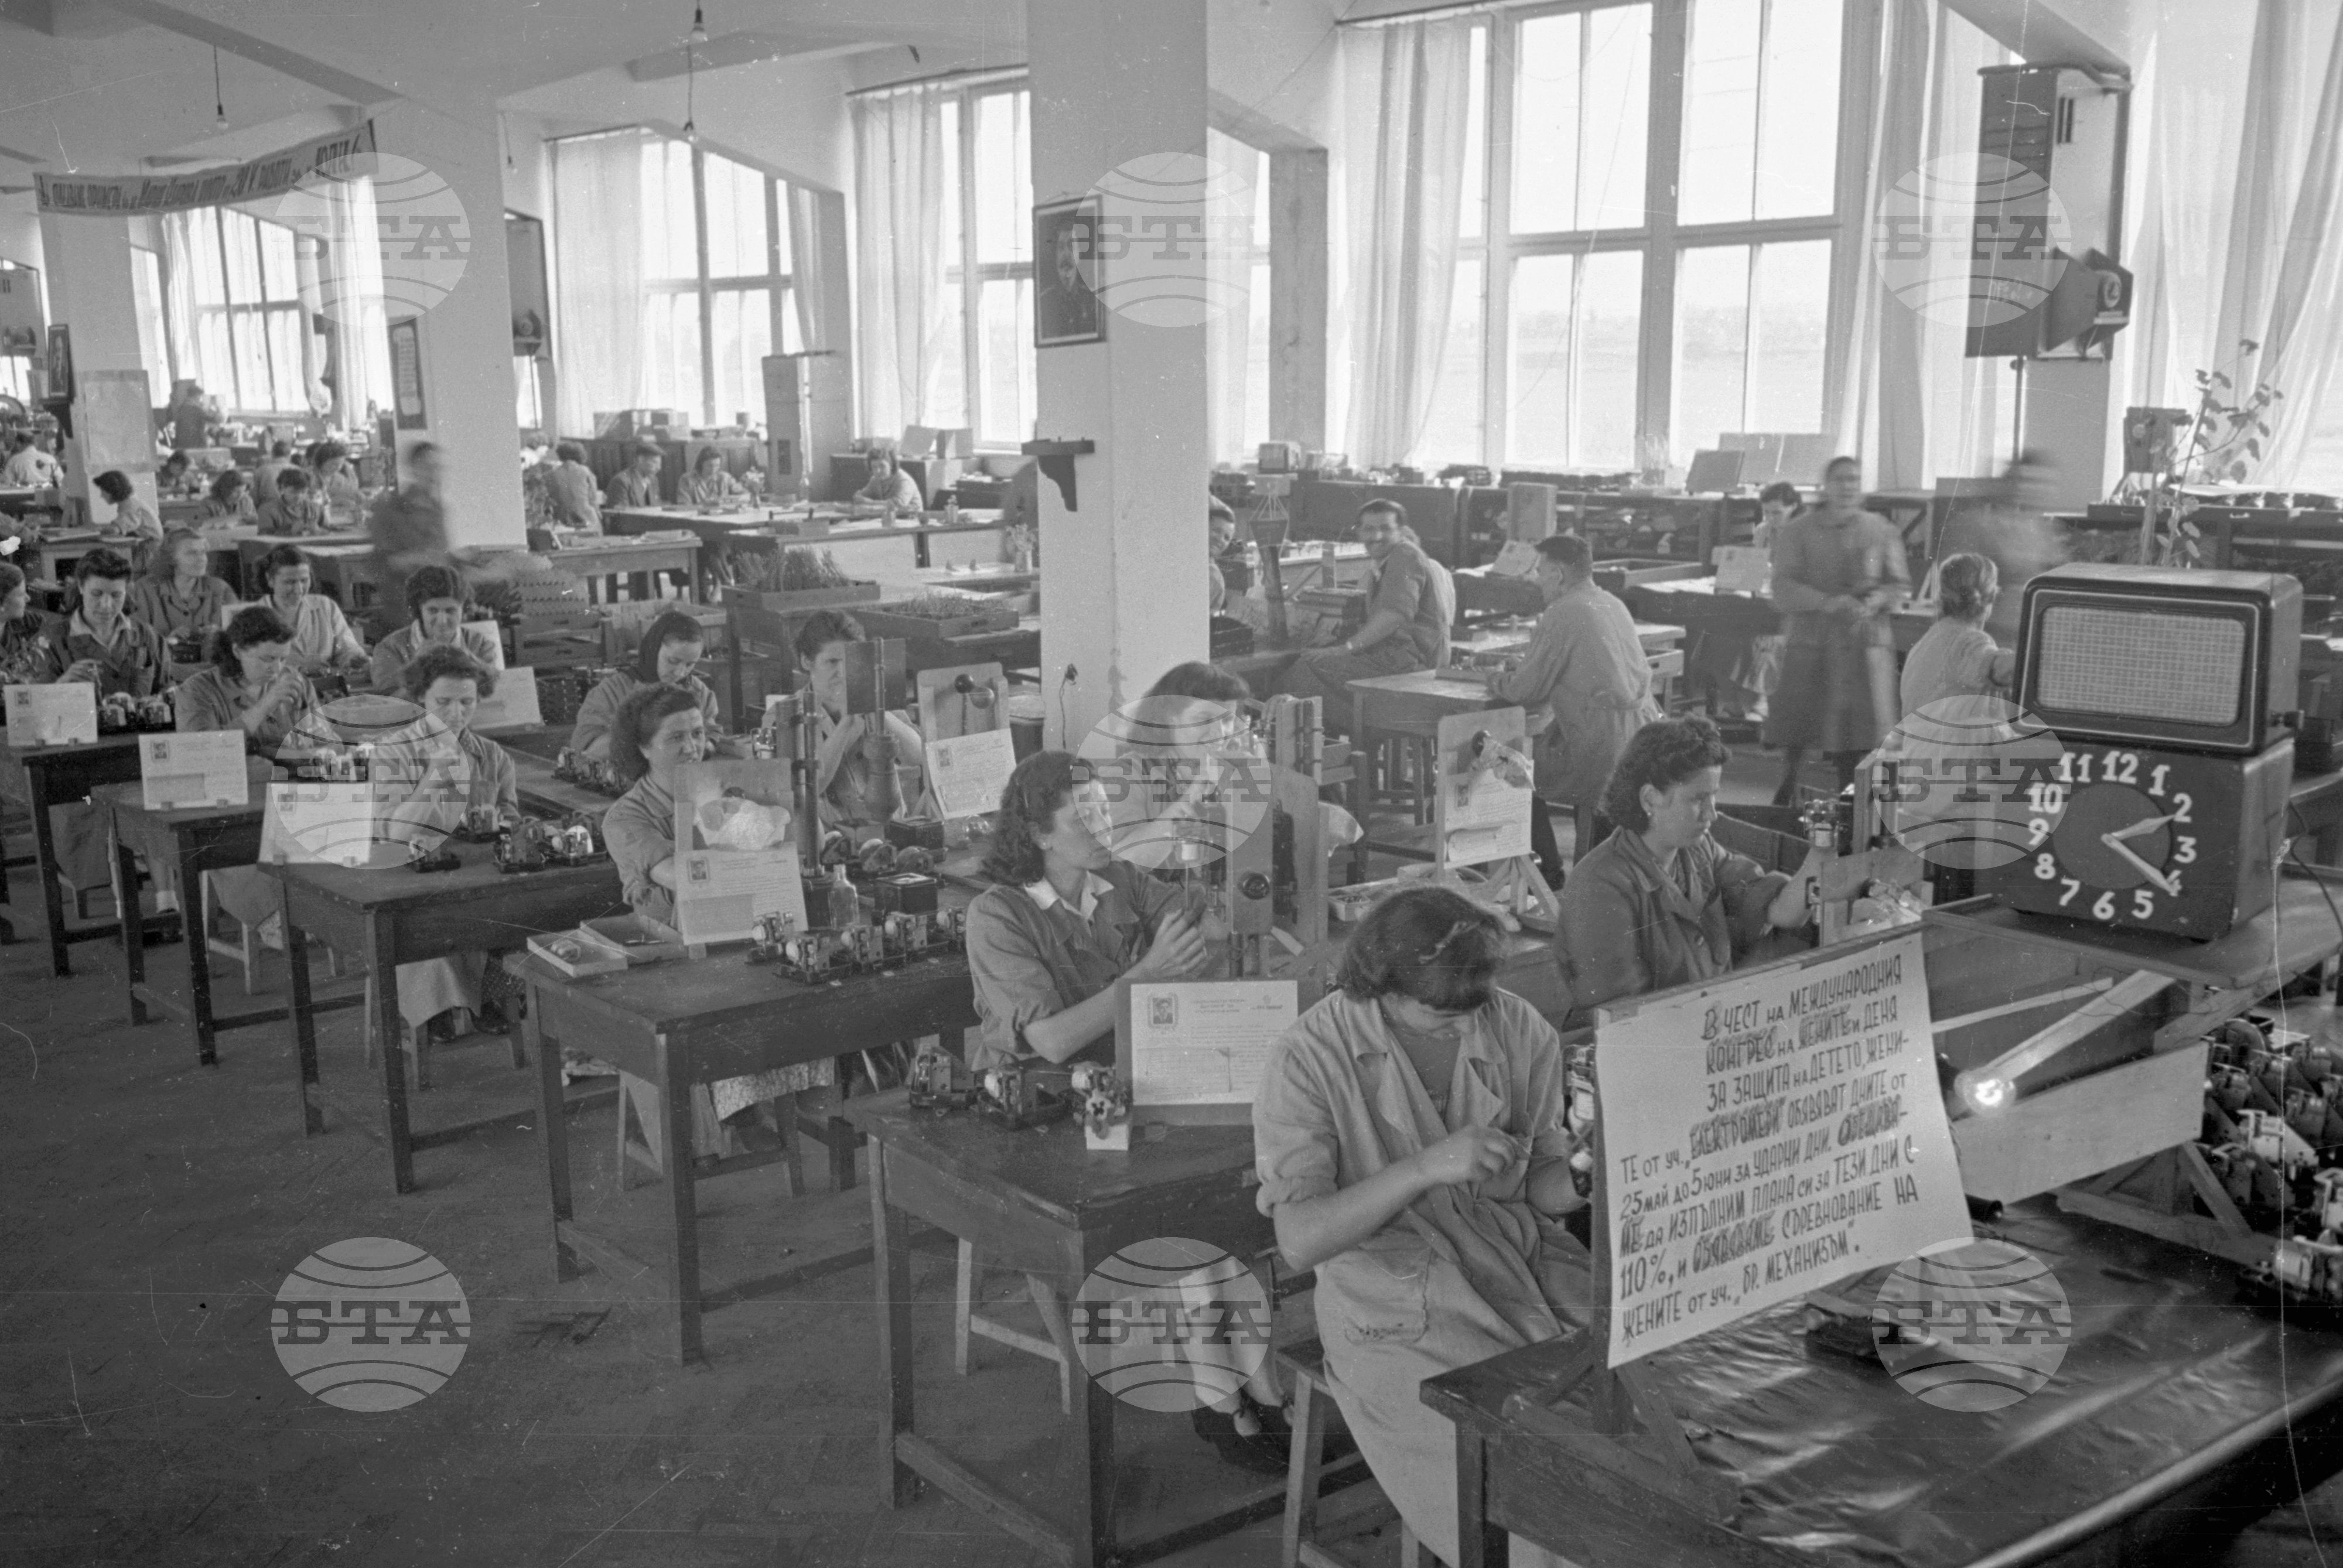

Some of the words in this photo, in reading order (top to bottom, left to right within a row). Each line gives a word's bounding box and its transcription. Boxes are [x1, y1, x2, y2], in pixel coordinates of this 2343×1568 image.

[2058, 752, 2093, 783] 11
[2102, 750, 2139, 784] 12
[2149, 764, 2171, 796] 1
[2028, 782, 2062, 815] 10
[2174, 792, 2192, 822] 2
[2028, 818, 2049, 846] 9
[2174, 835, 2197, 863] 3
[2034, 852, 2056, 879] 8
[2058, 877, 2081, 906] 7
[2166, 869, 2183, 897] 4
[2092, 891, 2115, 919] 6
[2130, 889, 2154, 919] 5
[1702, 1003, 1720, 1040] В
[1724, 1000, 1760, 1034] ЧЕСТ
[1789, 954, 1901, 1018] МЕЖДУНАРОДНИЯ
[1706, 1026, 1777, 1075] КОНГРЕС
[1864, 995, 1897, 1033] ДЕНЯ
[1707, 1081, 1726, 1112] ЗА
[1732, 1063, 1789, 1105] ЗАЩИТА
[1810, 1041, 1866, 1084] ДЕТЕТО,
[1866, 1030, 1909, 1064] ЖЕНИ-
[1621, 1154, 1638, 1184] ТЕ
[1642, 1155, 1660, 1177] ОТ
[1665, 1148, 1684, 1169] УЧ.
[1788, 1082, 1846, 1128] ОБЯВЯВАТ
[1850, 1069, 1887, 1106] ДНИТЕ
[1891, 1073, 1907, 1090] ОТ
[1620, 1190, 1643, 1221] 25
[1673, 1181, 1689, 1204] ДО
[1691, 1167, 1702, 1196] 5
[1703, 1168, 1731, 1192] ЮНИ
[1734, 1163, 1750, 1182] ЗА
[1753, 1137, 1800, 1178] УДАРНИ
[1804, 1125, 1832, 1163] ДНИ.
[1620, 1215, 1644, 1258] МЕ
[1669, 1190, 1745, 1242] ИЗПЪЛНИМ
[1752, 1174, 1794, 1214] ПЛАНА
[1815, 1170, 1830, 1191] ЗА
[1834, 1148, 1866, 1184] ТЕЗИ
[1870, 1138, 1898, 1176] ДНИ
[1904, 1135, 1914, 1163] С
[1782, 1181, 1882, 1239] СЪРЕВНОВАНИЕ
[1894, 1174, 1918, 1205] НА
[1622, 1290, 1682, 1343] ЖЕНИТЕ
[1688, 1292, 1707, 1314] ОТ
